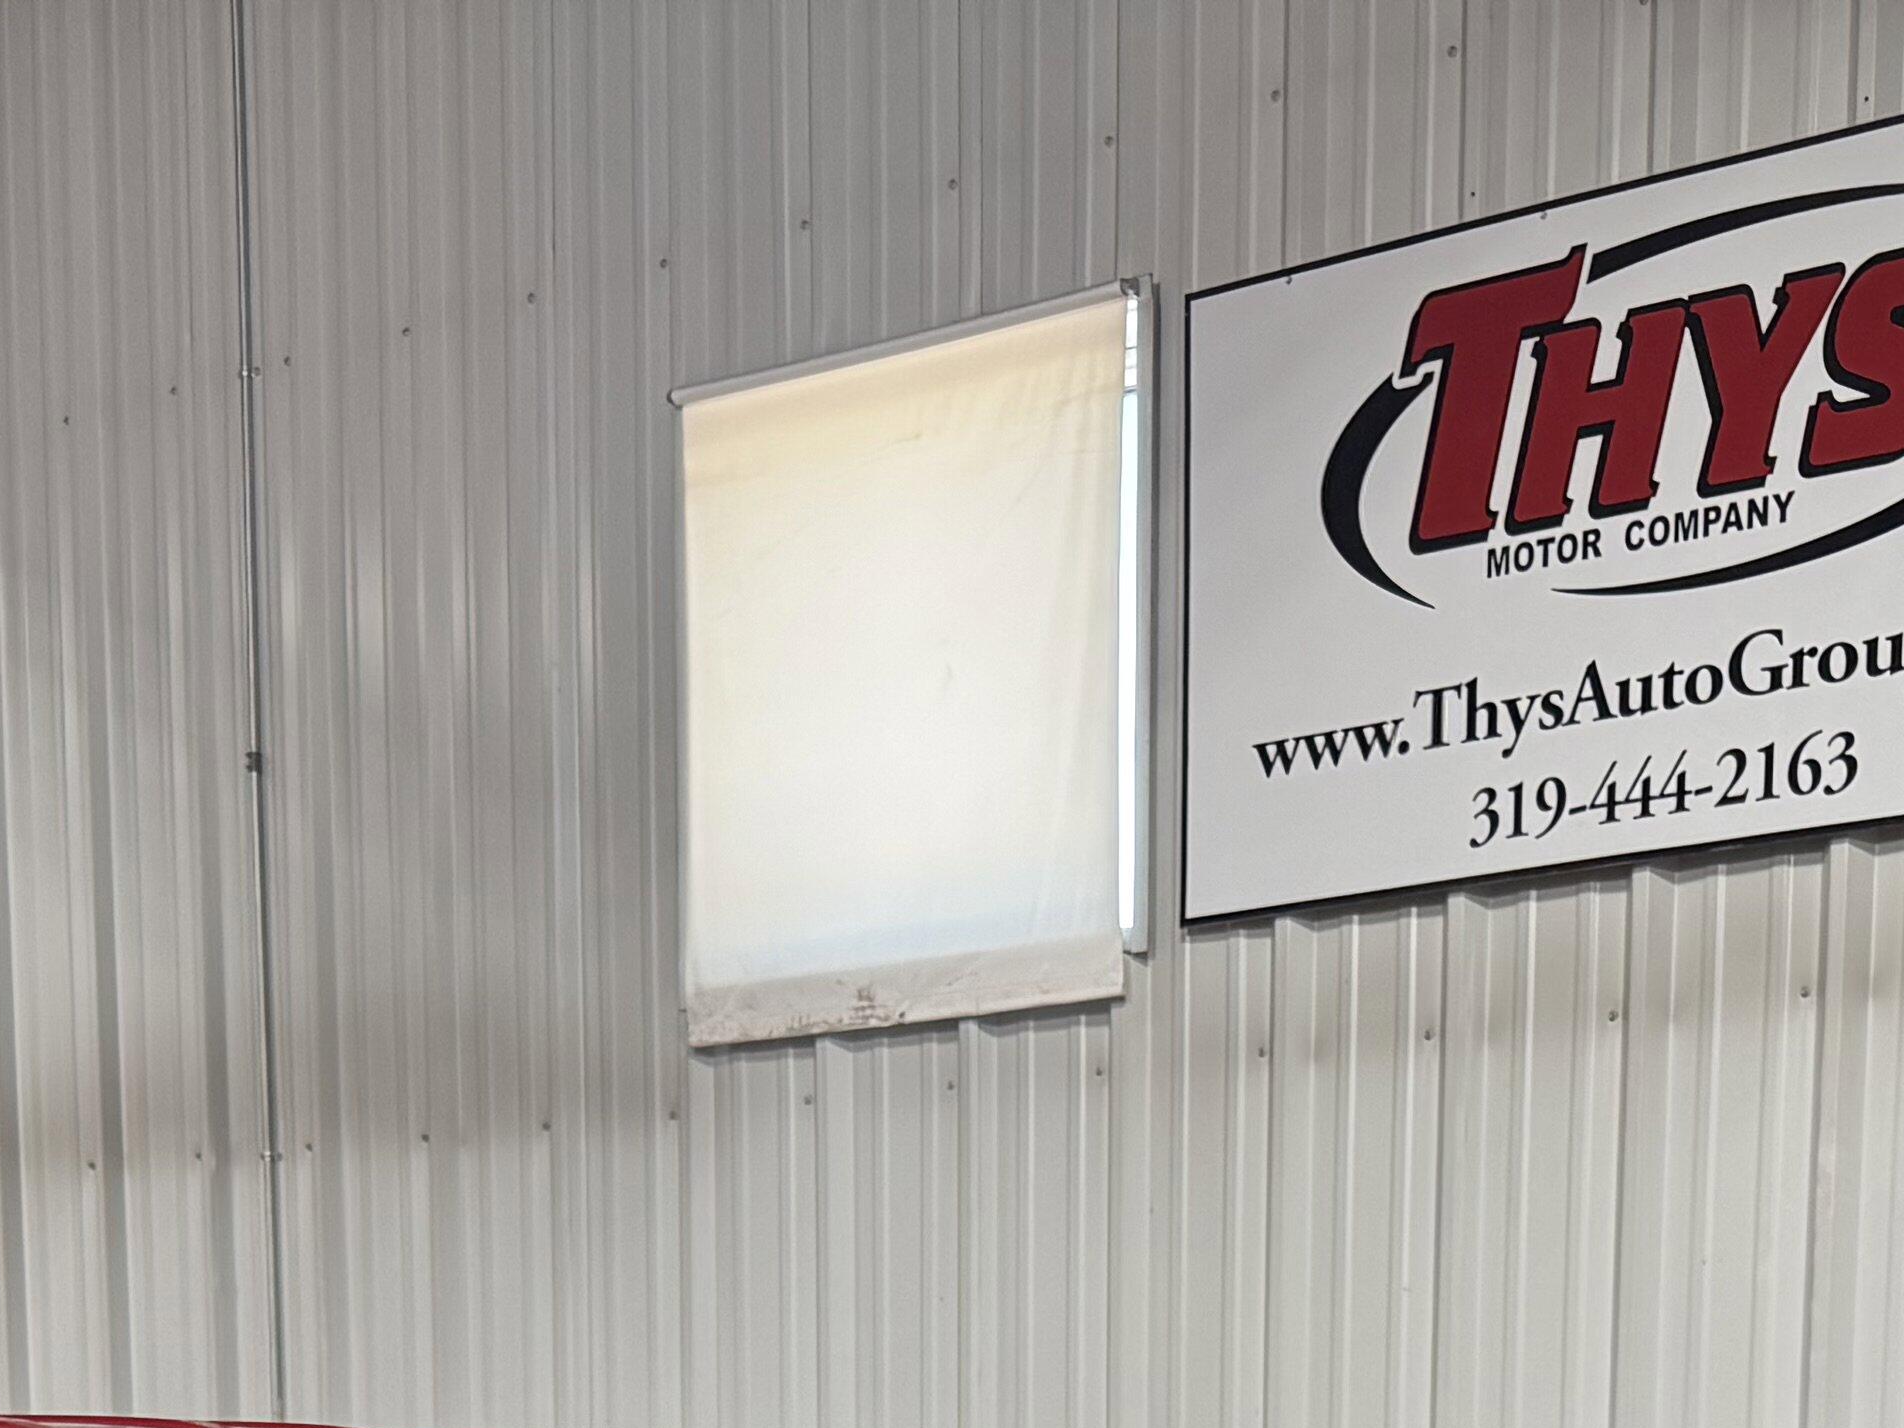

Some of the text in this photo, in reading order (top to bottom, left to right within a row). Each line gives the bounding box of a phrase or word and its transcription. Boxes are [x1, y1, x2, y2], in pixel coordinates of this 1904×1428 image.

[1486, 490, 1795, 579] MOTOR COMPANY
[1469, 730, 1860, 848] 319-444-2163
